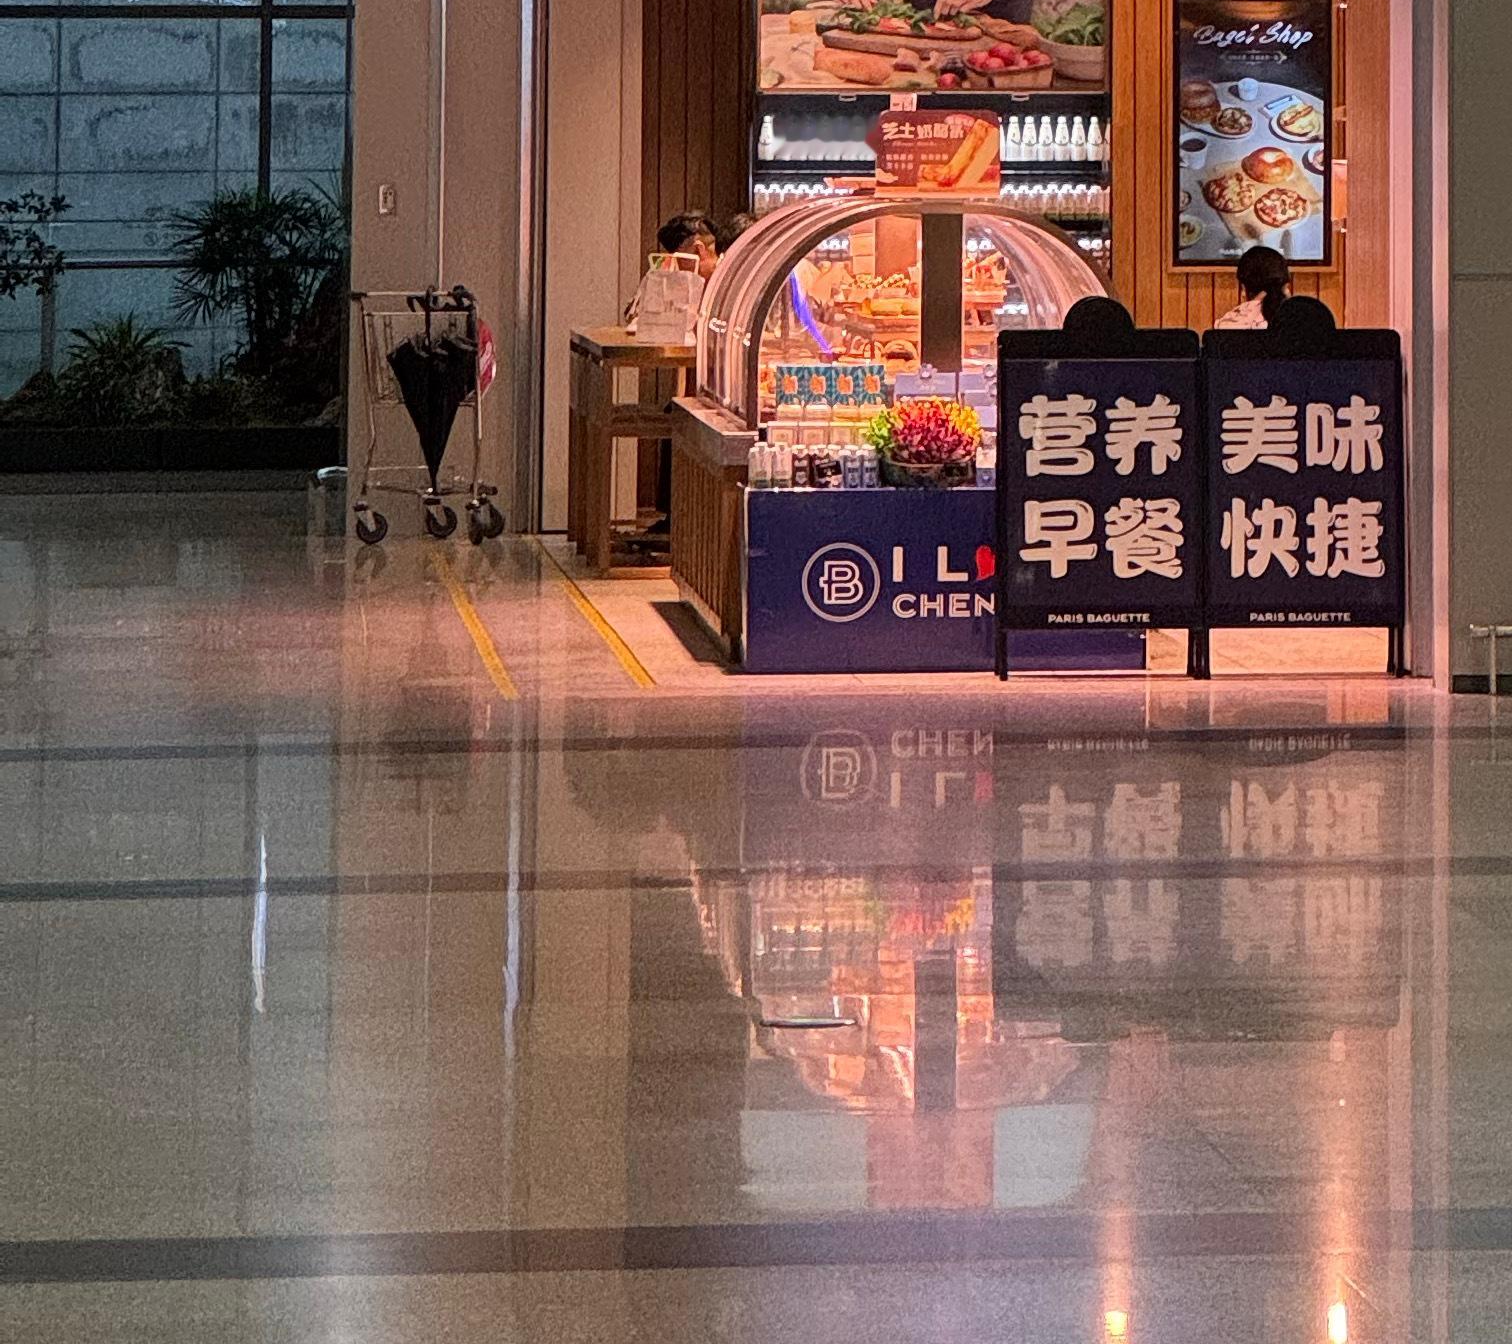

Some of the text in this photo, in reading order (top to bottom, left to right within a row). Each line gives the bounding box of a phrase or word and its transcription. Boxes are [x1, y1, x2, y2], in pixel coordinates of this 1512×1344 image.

[1259, 21, 1314, 49] Shop
[1019, 393, 1184, 478] 营养
[1220, 393, 1384, 476] 美味
[1019, 497, 1184, 579] 早餐
[1221, 496, 1385, 579] 快捷
[1048, 613, 1150, 623] PARIS BAGUETTE
[1249, 612, 1351, 622] PARIS BAGUETTE
